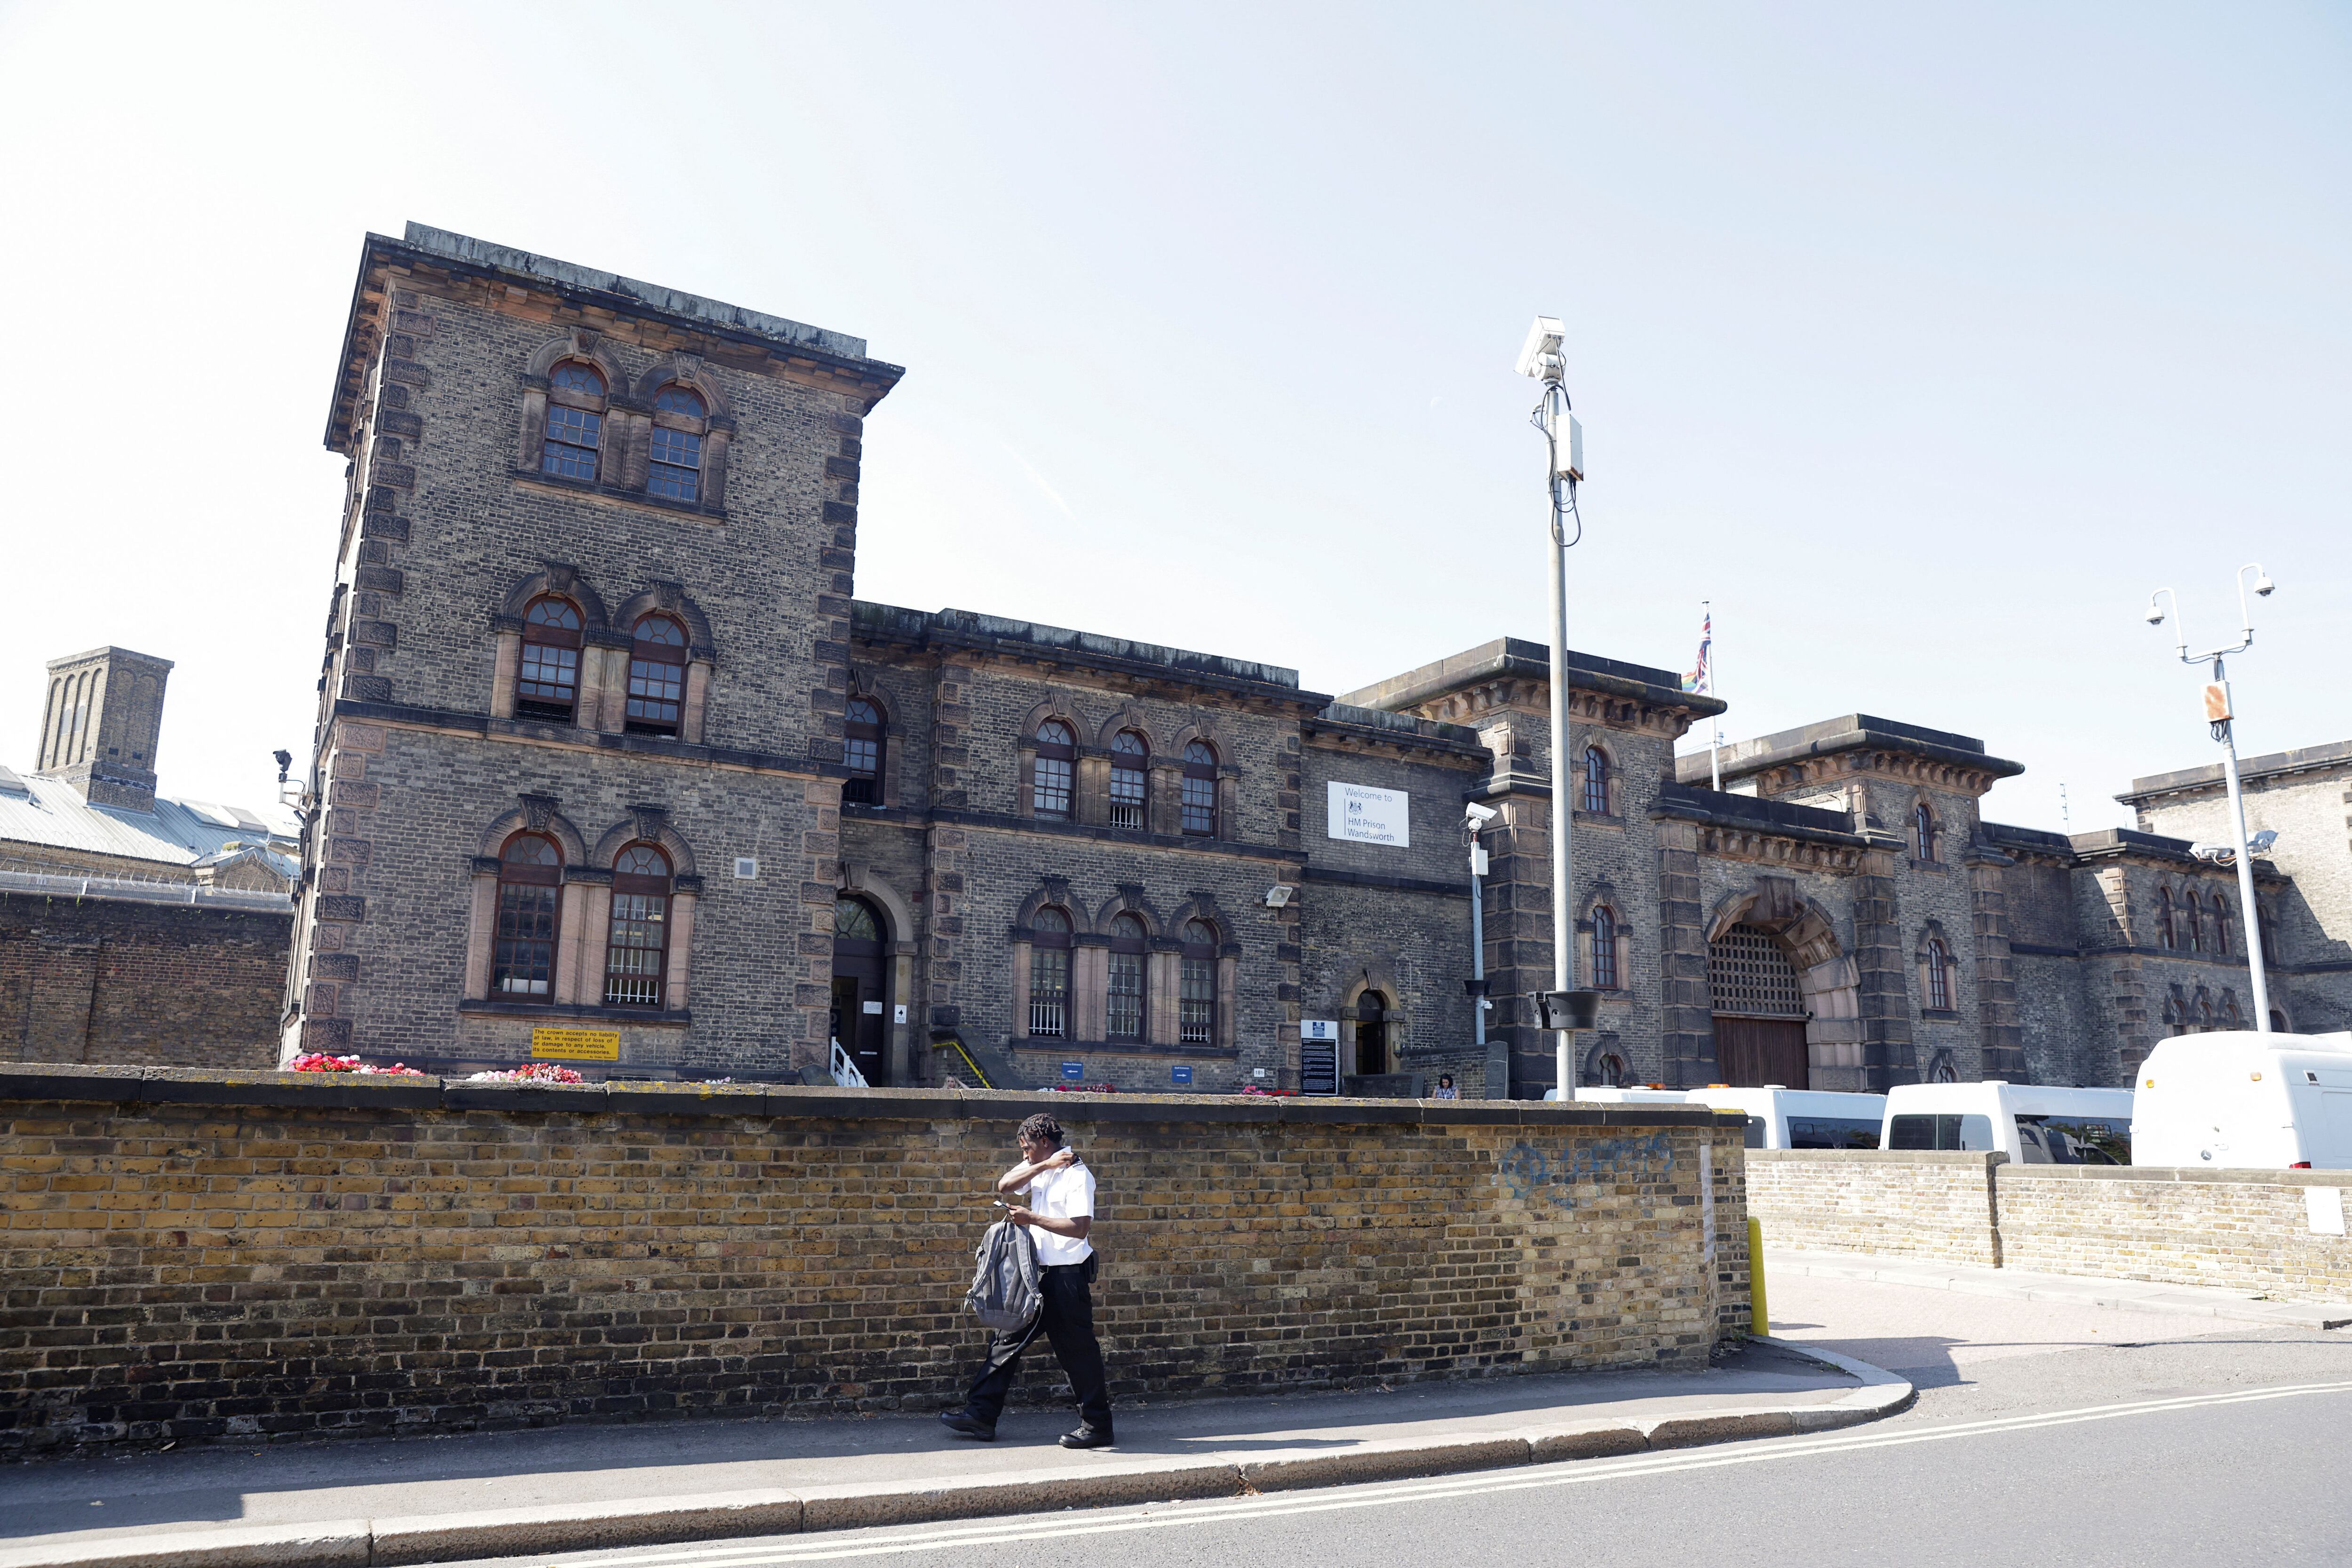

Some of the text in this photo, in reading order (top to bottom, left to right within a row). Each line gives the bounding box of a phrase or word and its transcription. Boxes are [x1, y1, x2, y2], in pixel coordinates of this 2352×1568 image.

[1345, 788, 1392, 802] Welcome to
[1348, 817, 1385, 829] HM Prison
[1348, 828, 1394, 842] Wandsworth
